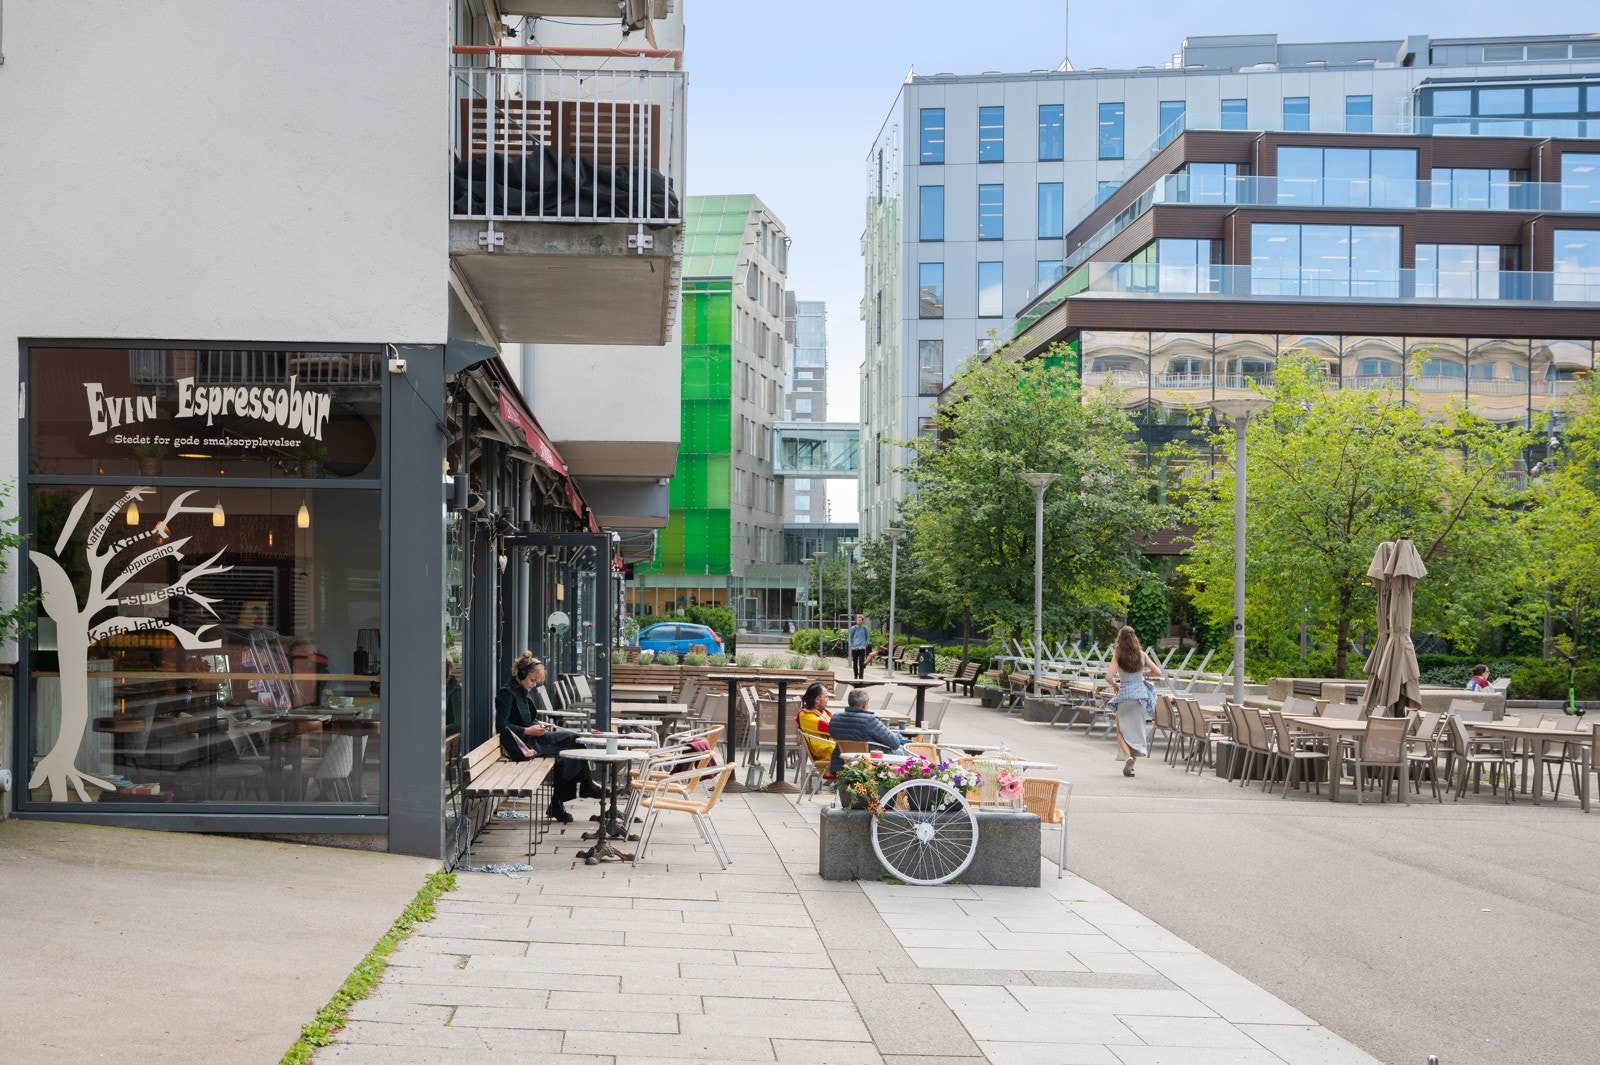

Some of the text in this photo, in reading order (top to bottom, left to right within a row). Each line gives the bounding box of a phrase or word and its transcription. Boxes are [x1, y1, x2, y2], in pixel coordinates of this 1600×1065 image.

[174, 374, 332, 441] Espressobar
[114, 434, 302, 449] Stedet for gode smaksopplevelser
[121, 544, 174, 576] appuccino
